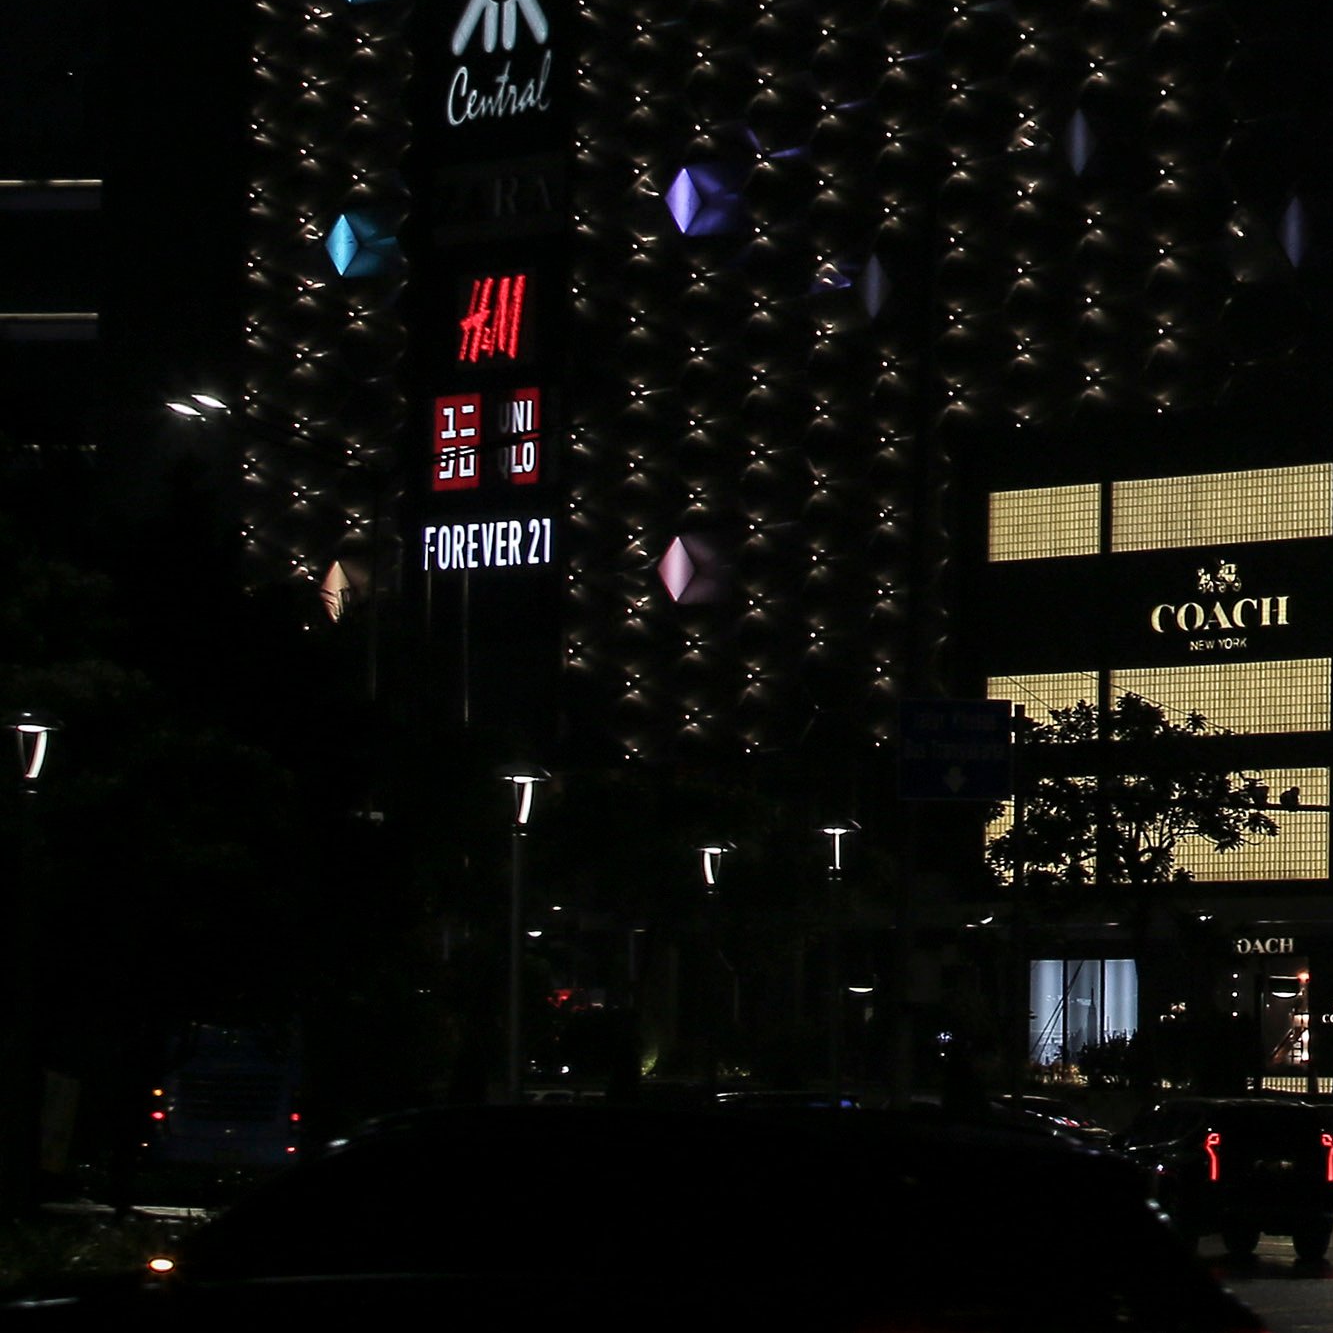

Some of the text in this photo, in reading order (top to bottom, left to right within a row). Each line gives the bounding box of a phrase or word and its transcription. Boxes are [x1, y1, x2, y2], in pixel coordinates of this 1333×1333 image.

[447, 49, 552, 126] Central
[424, 517, 551, 571] FOREVER 21
[1151, 596, 1290, 633] COACH
[1189, 637, 1247, 651] NEW YORK
[1233, 937, 1294, 955] OACH
